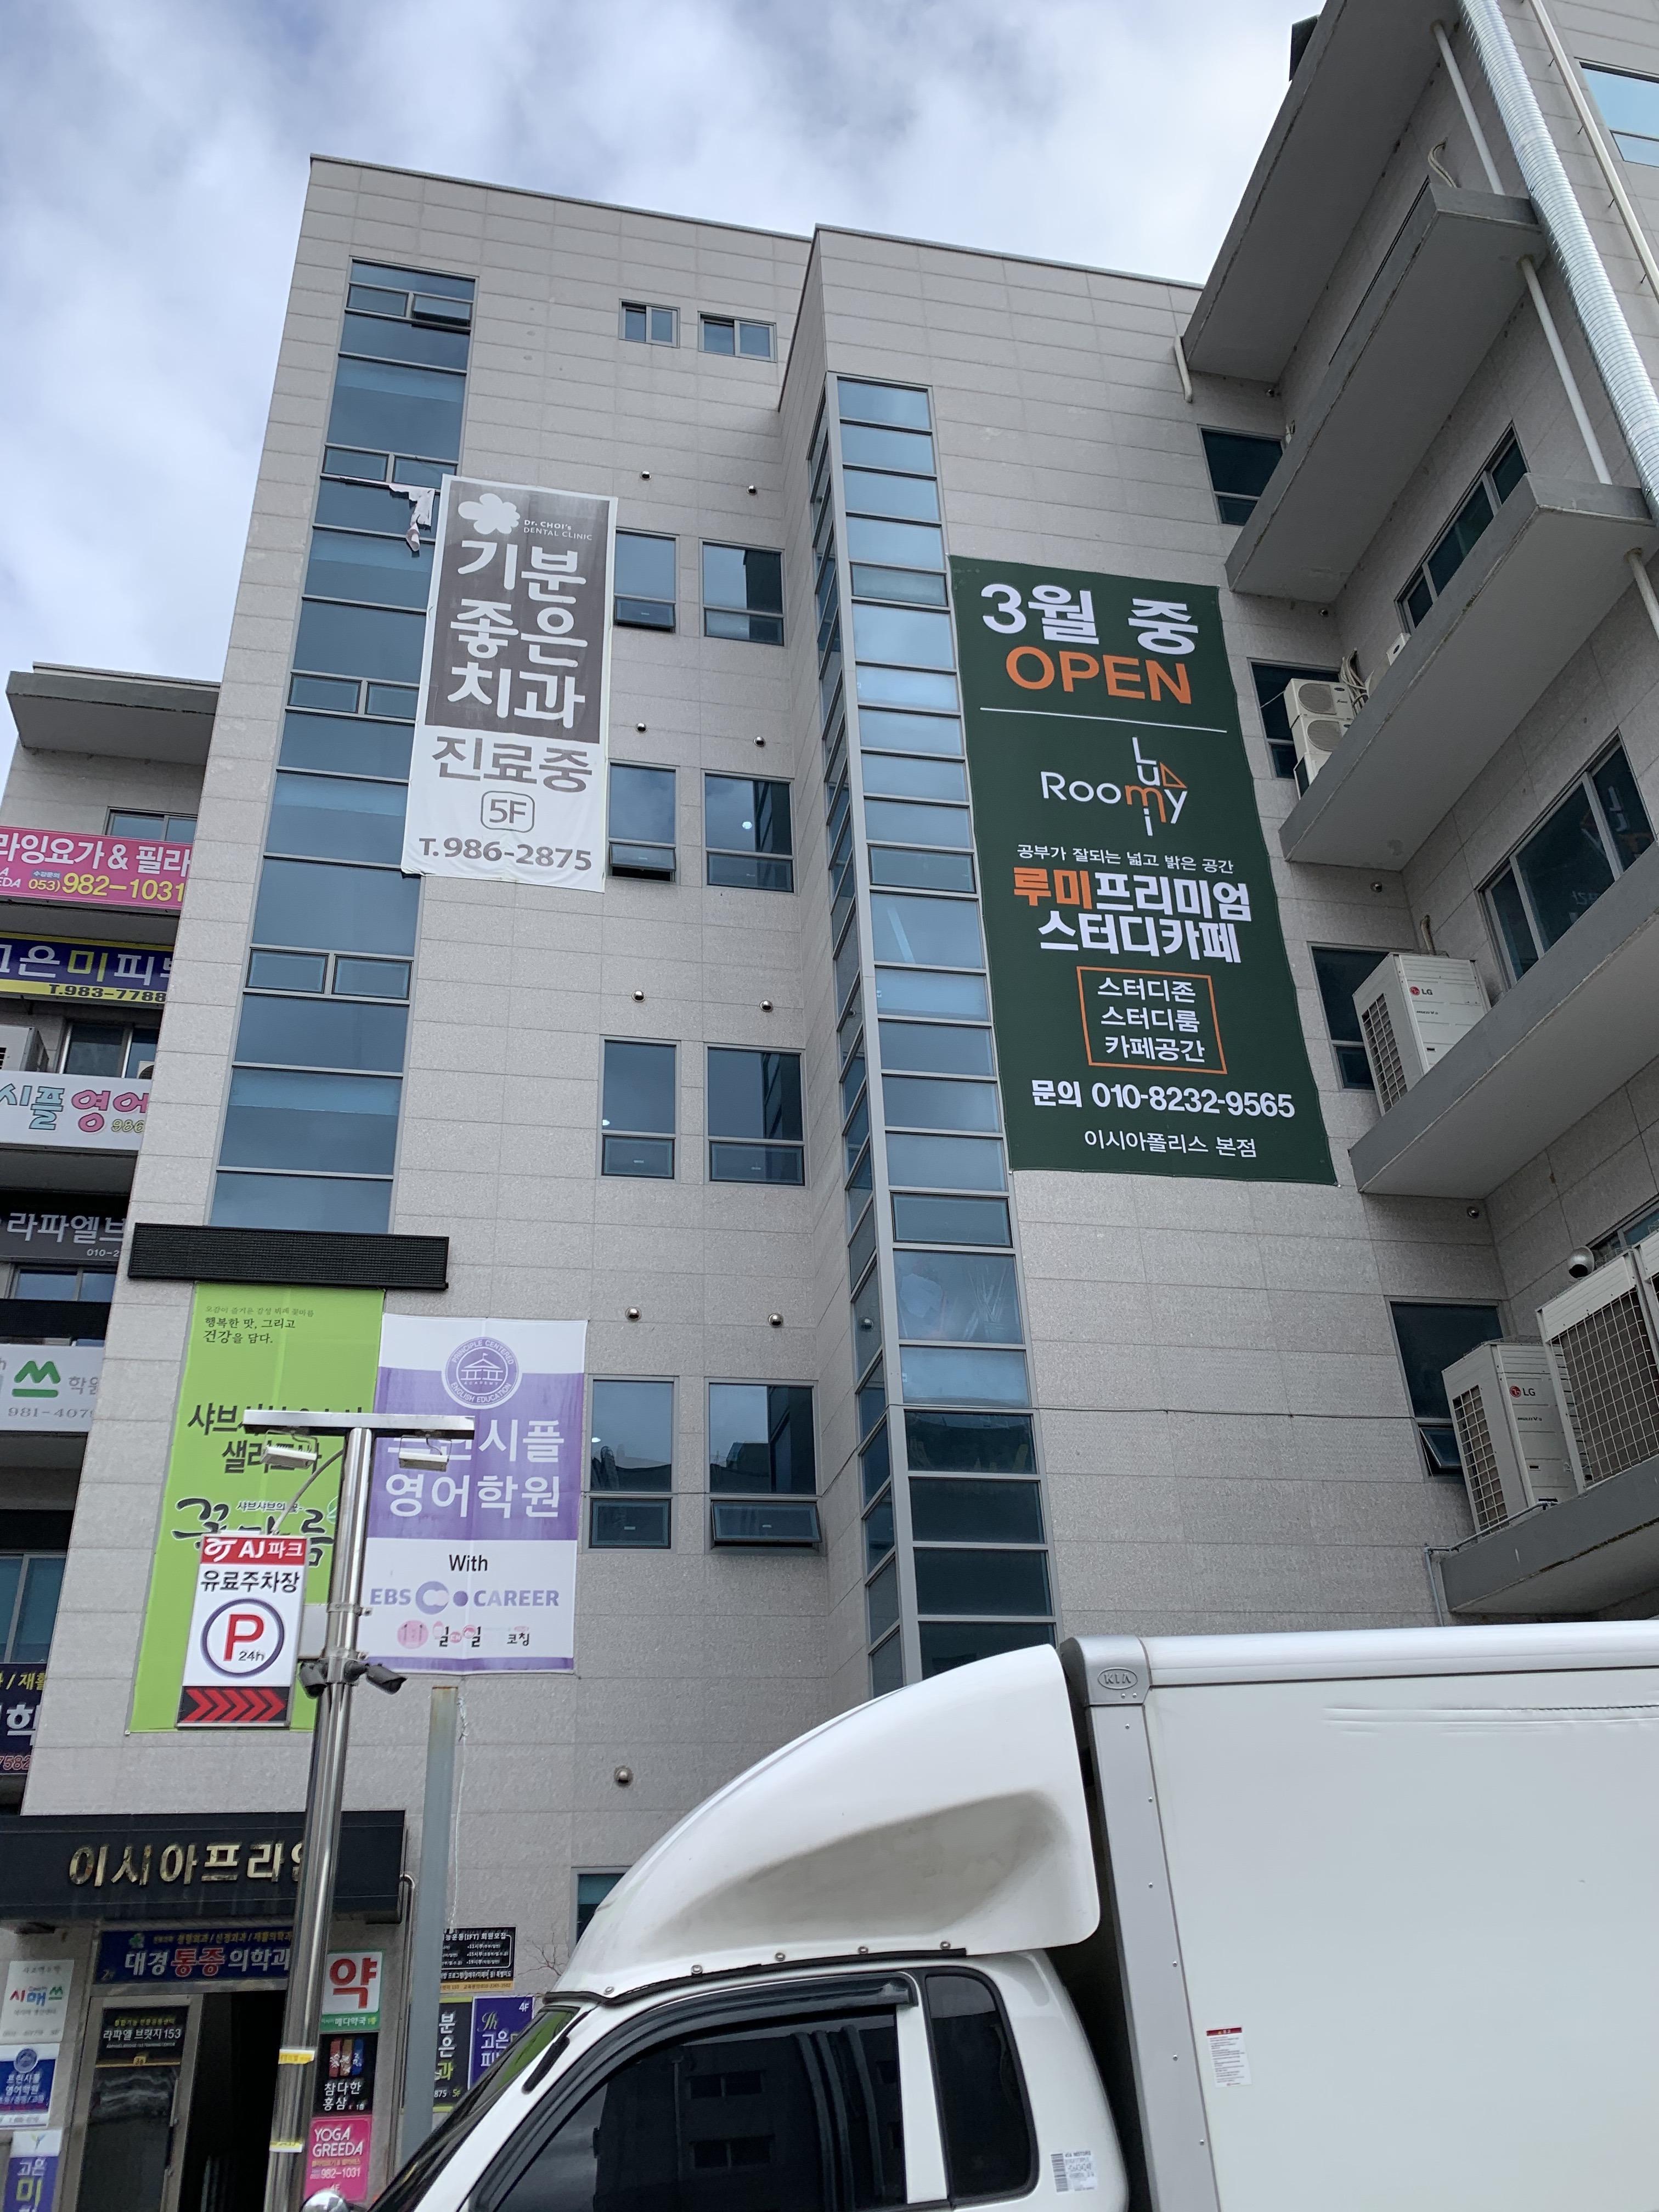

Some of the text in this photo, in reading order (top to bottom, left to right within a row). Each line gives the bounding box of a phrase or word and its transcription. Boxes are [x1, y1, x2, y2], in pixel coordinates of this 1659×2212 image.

[523, 527, 592, 540] DENTAL CLINIC
[458, 540, 587, 605] 기분
[980, 583, 1199, 655] 3월 중
[450, 598, 588, 668] 좋은
[1005, 646, 1192, 704] OPEN
[447, 662, 586, 729] 치과
[431, 735, 592, 793] 진료중
[488, 798, 527, 825] 5F
[108, 844, 129, 870] &
[419, 837, 592, 871] T.986-2875
[1017, 844, 1234, 875] 공부가 잘되는 넓고 밝은 공간
[1013, 866, 1252, 922] 루미프리미엄
[1037, 910, 1242, 964] 스터디카페
[1097, 977, 1197, 1004] 스터디존
[1101, 1006, 1200, 1034] 스터디룸
[1104, 1035, 1206, 1063] 카페공간
[1031, 1079, 1296, 1119] 문의 010-8232-9565
[1084, 1129, 1257, 1159] 이시아폴리스 본점
[203, 1329, 244, 1344] 건강을
[205, 1317, 240, 1329] 행복한
[261, 1318, 296, 1329] 그리고
[451, 1339, 515, 1365] PRINCIPLE CENTERED
[450, 1382, 512, 1403] ENGLISH EDUCATION
[385, 1473, 560, 1519] 영어학원
[449, 1554, 488, 1572] With
[200, 1570, 300, 1593] 유료주차장
[370, 1588, 560, 1607] EBS CAREER
[223, 1613, 265, 1662] P
[238, 1650, 265, 1662] 24h
[1103, 1673, 1132, 1685] KIA
[329, 1956, 377, 2009] 약
[518, 2002, 529, 2012] 4F
[103, 2029, 132, 2041] 라파엘
[163, 2028, 182, 2039] 153
[481, 2030, 518, 2049] 고은
[314, 2127, 351, 2142] YOGA
[312, 2141, 364, 2158] GREEDA
